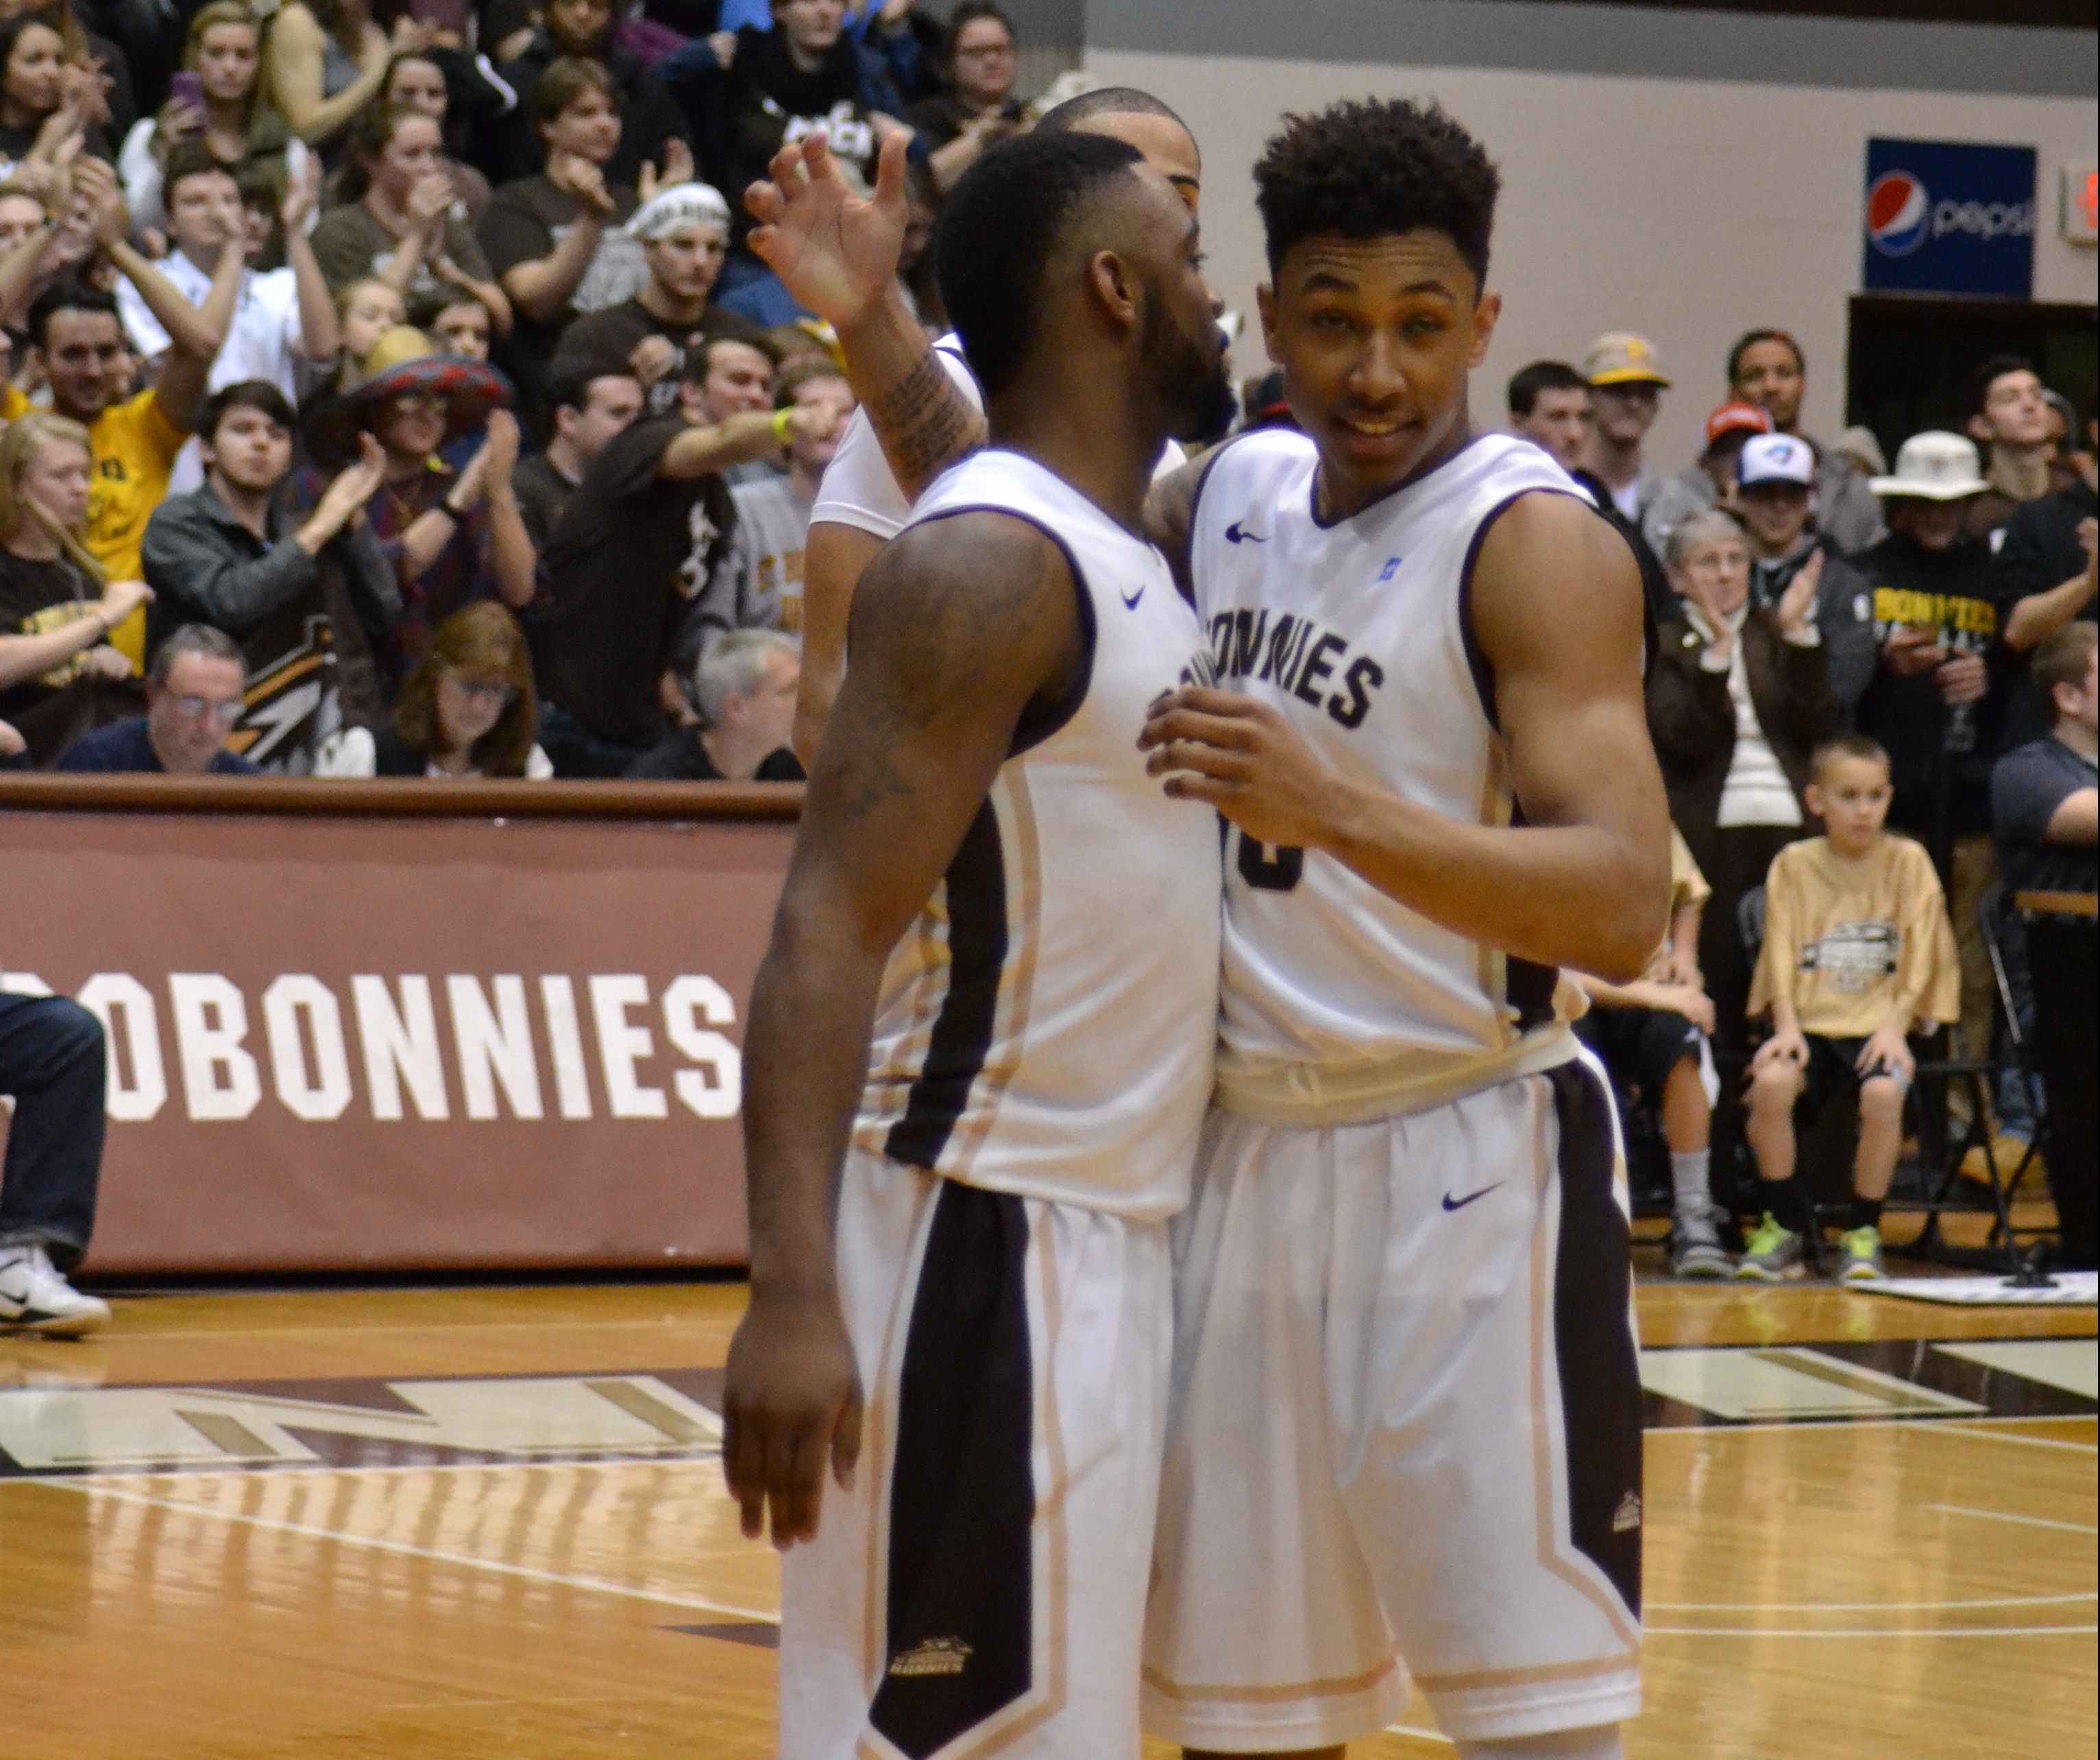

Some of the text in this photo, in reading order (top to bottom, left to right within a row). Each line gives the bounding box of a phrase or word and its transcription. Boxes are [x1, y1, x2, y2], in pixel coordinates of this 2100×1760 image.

[1933, 199, 2034, 241] pepsi
[1206, 609, 1384, 730] ONNIES
[0, 971, 741, 1121] OBONNIES
